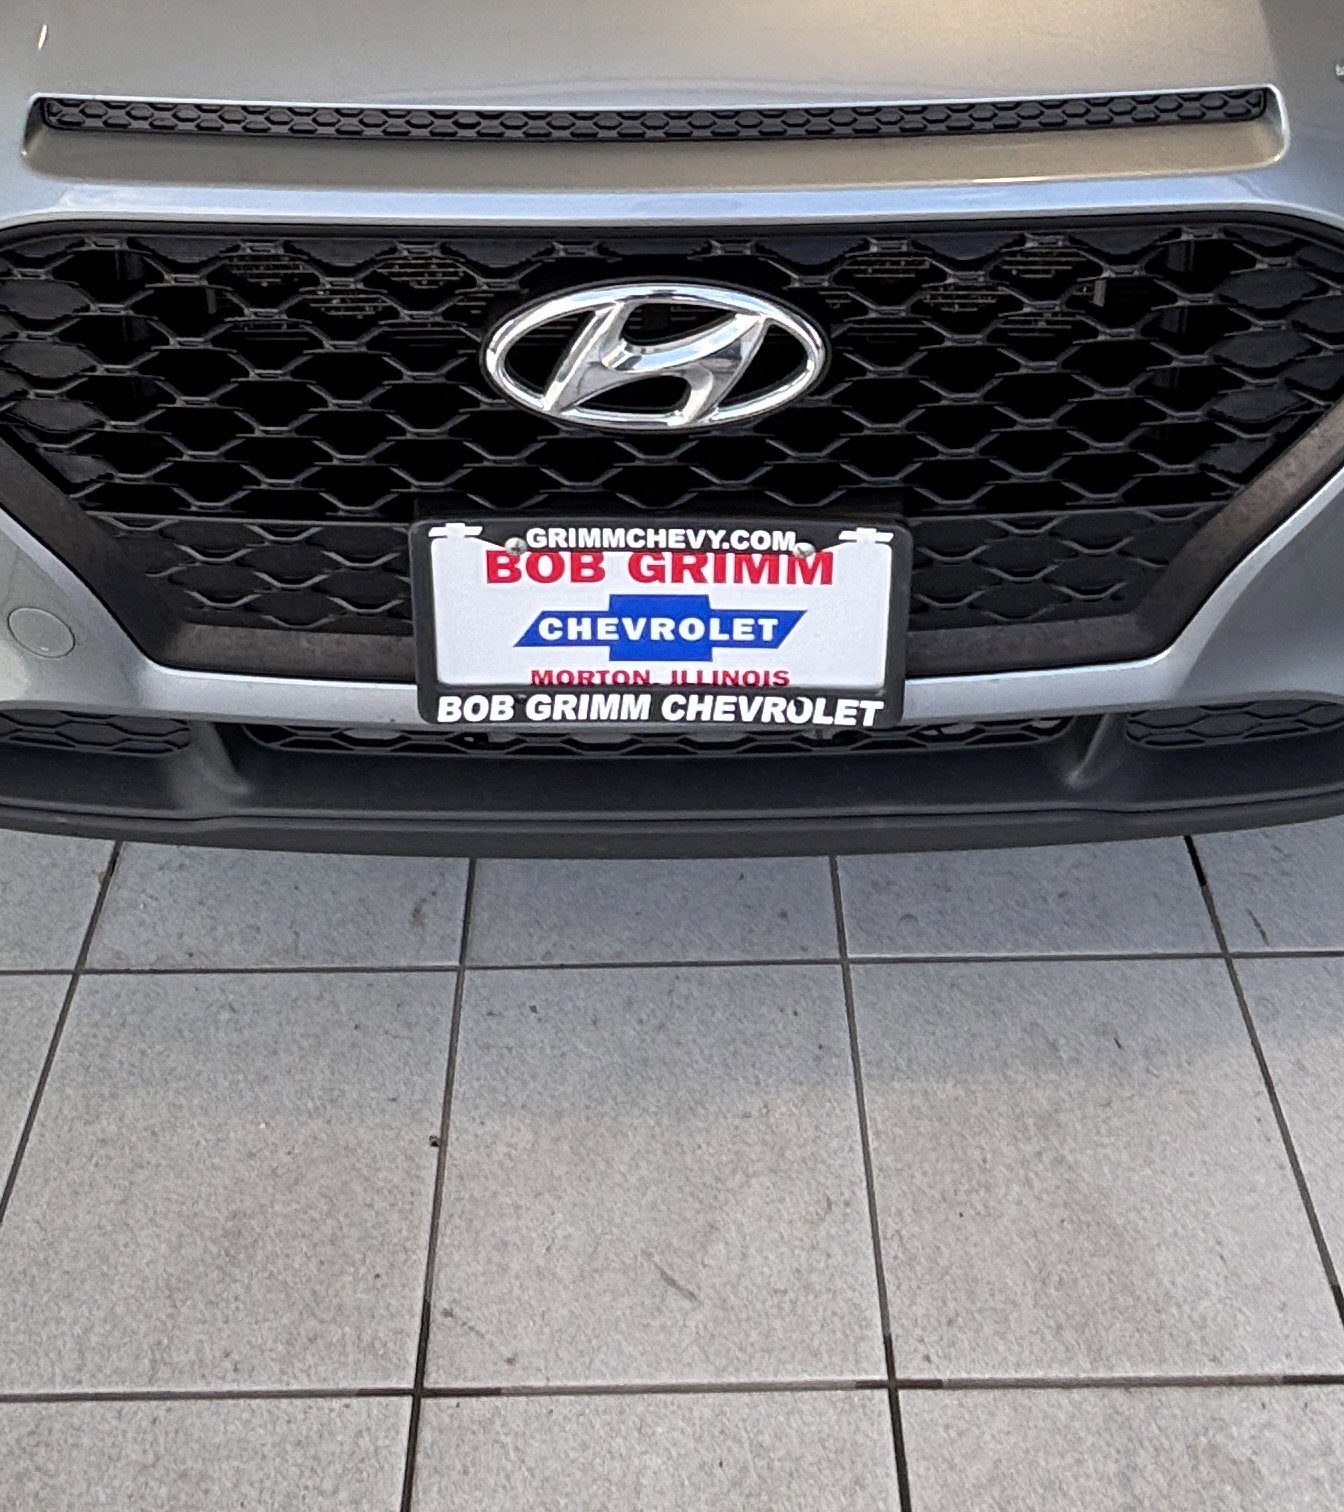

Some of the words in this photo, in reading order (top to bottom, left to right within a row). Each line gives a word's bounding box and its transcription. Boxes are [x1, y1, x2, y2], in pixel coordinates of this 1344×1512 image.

[525, 527, 796, 552] GRIMMCHEVY.COM
[485, 550, 607, 585] BOB
[628, 550, 834, 586] GRIMM
[537, 616, 780, 642] CHEVROLET
[670, 669, 791, 688] ILLINOIS
[437, 694, 515, 724] BOB
[525, 694, 651, 724] GRIMM
[660, 695, 884, 727] CHEVROLET
